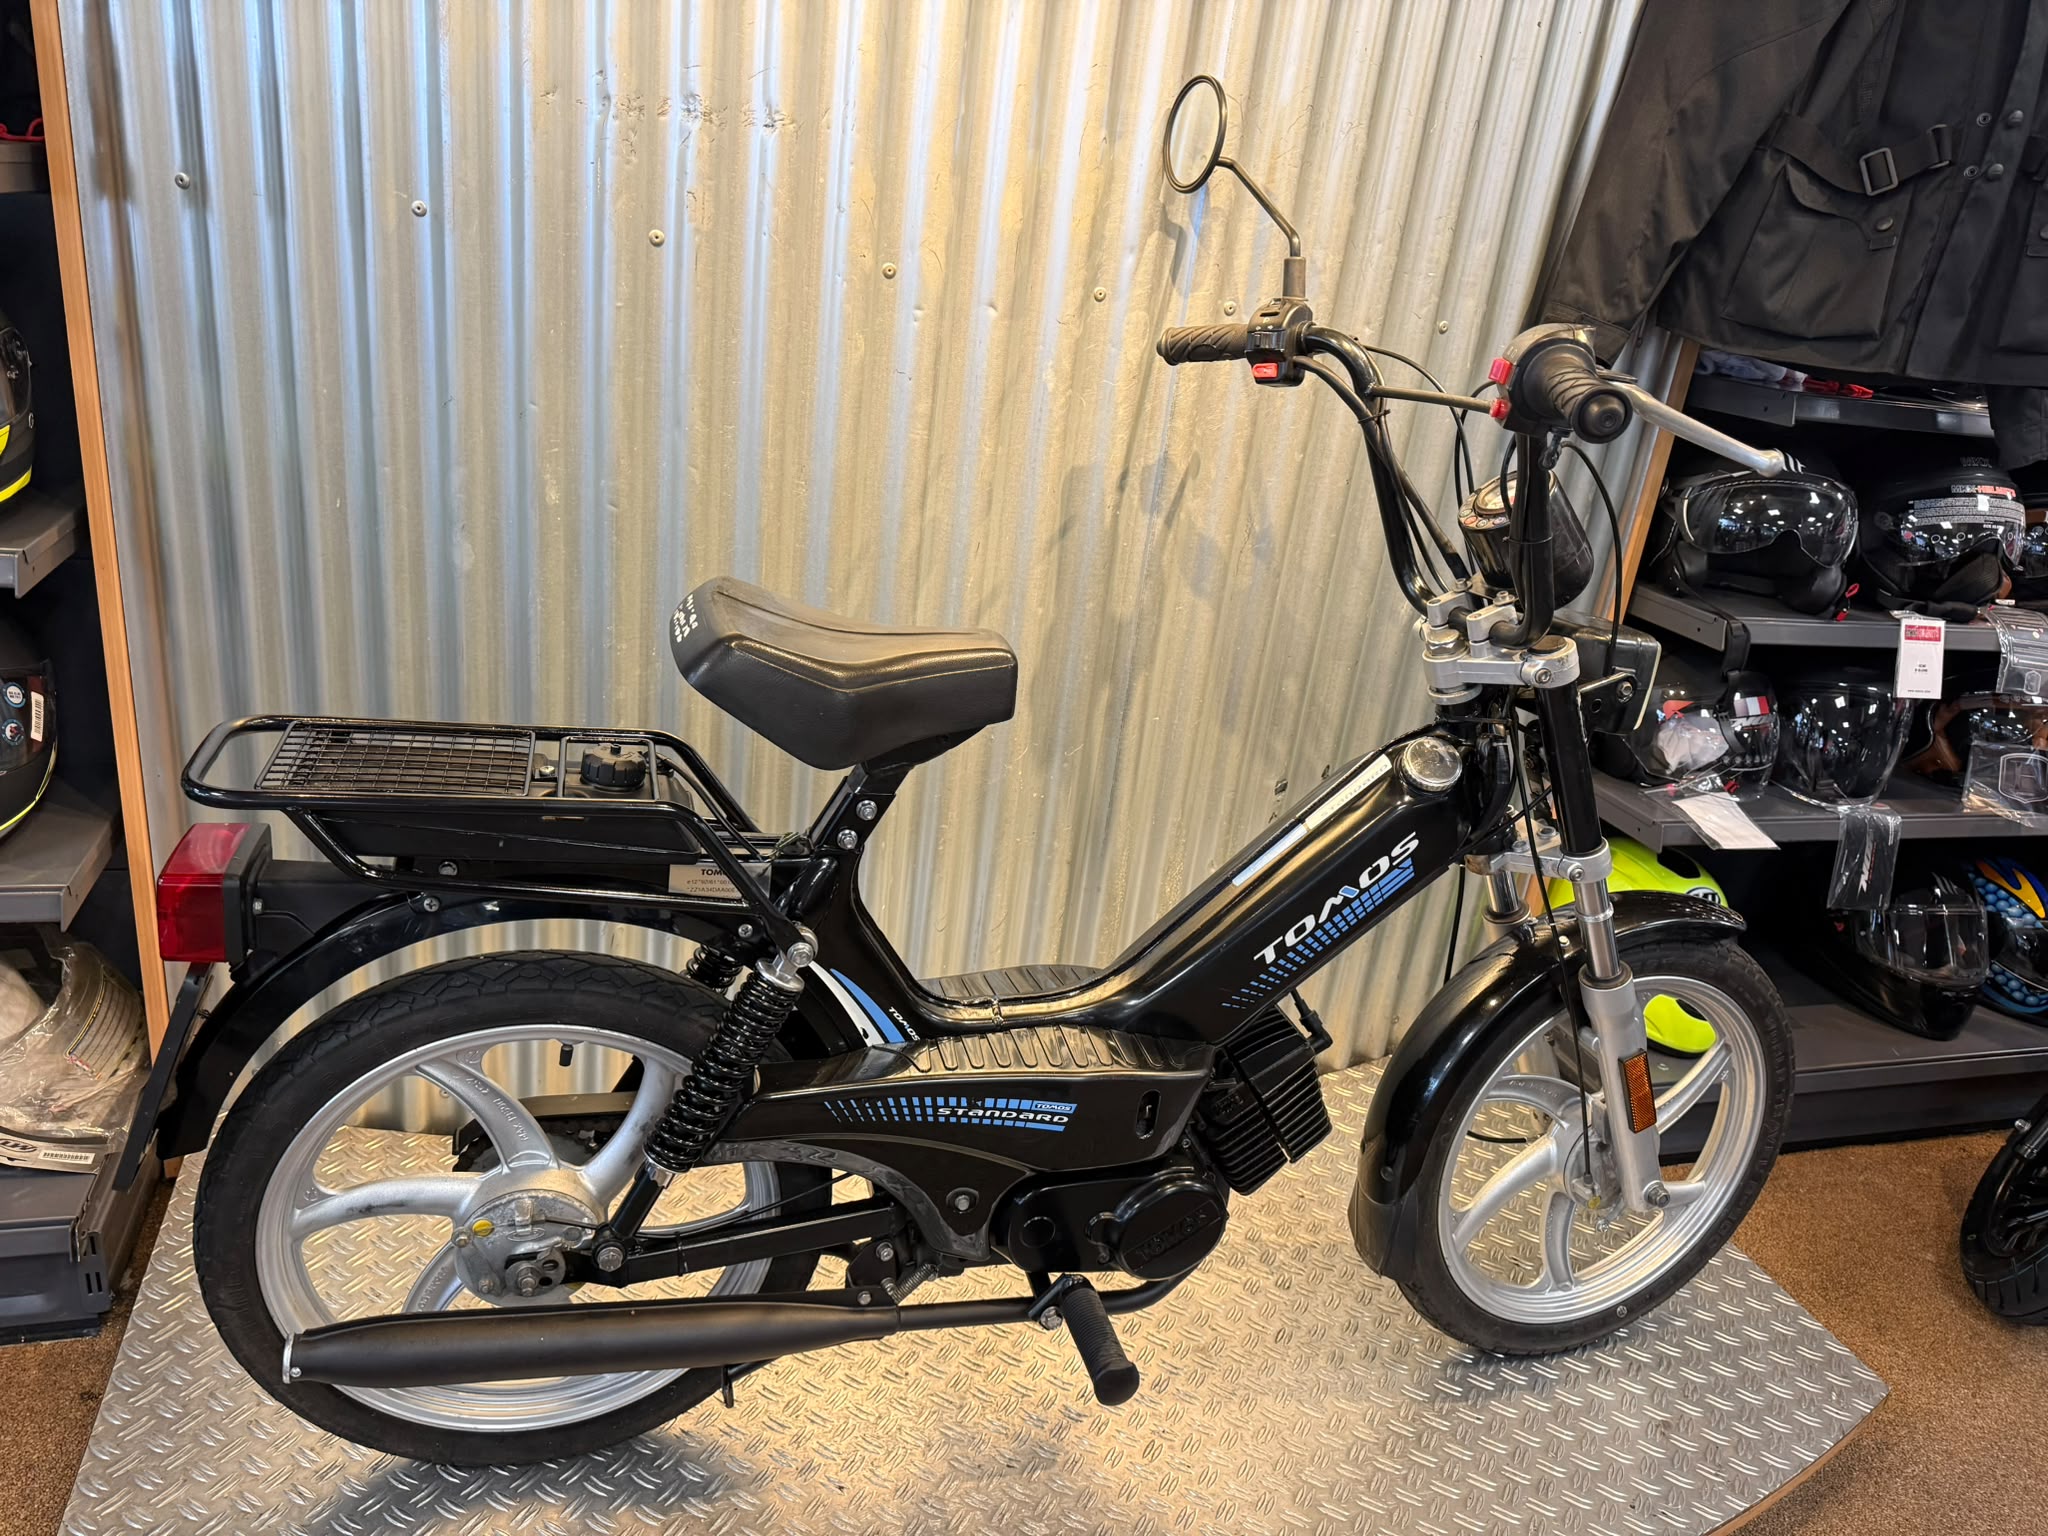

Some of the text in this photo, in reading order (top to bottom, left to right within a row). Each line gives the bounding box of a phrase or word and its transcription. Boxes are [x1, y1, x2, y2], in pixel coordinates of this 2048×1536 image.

[701, 868, 727, 876] TOM
[1253, 831, 1421, 965] TOMOS
[888, 1006, 921, 1041] TOMOS
[1036, 1103, 1072, 1111] TOMOS
